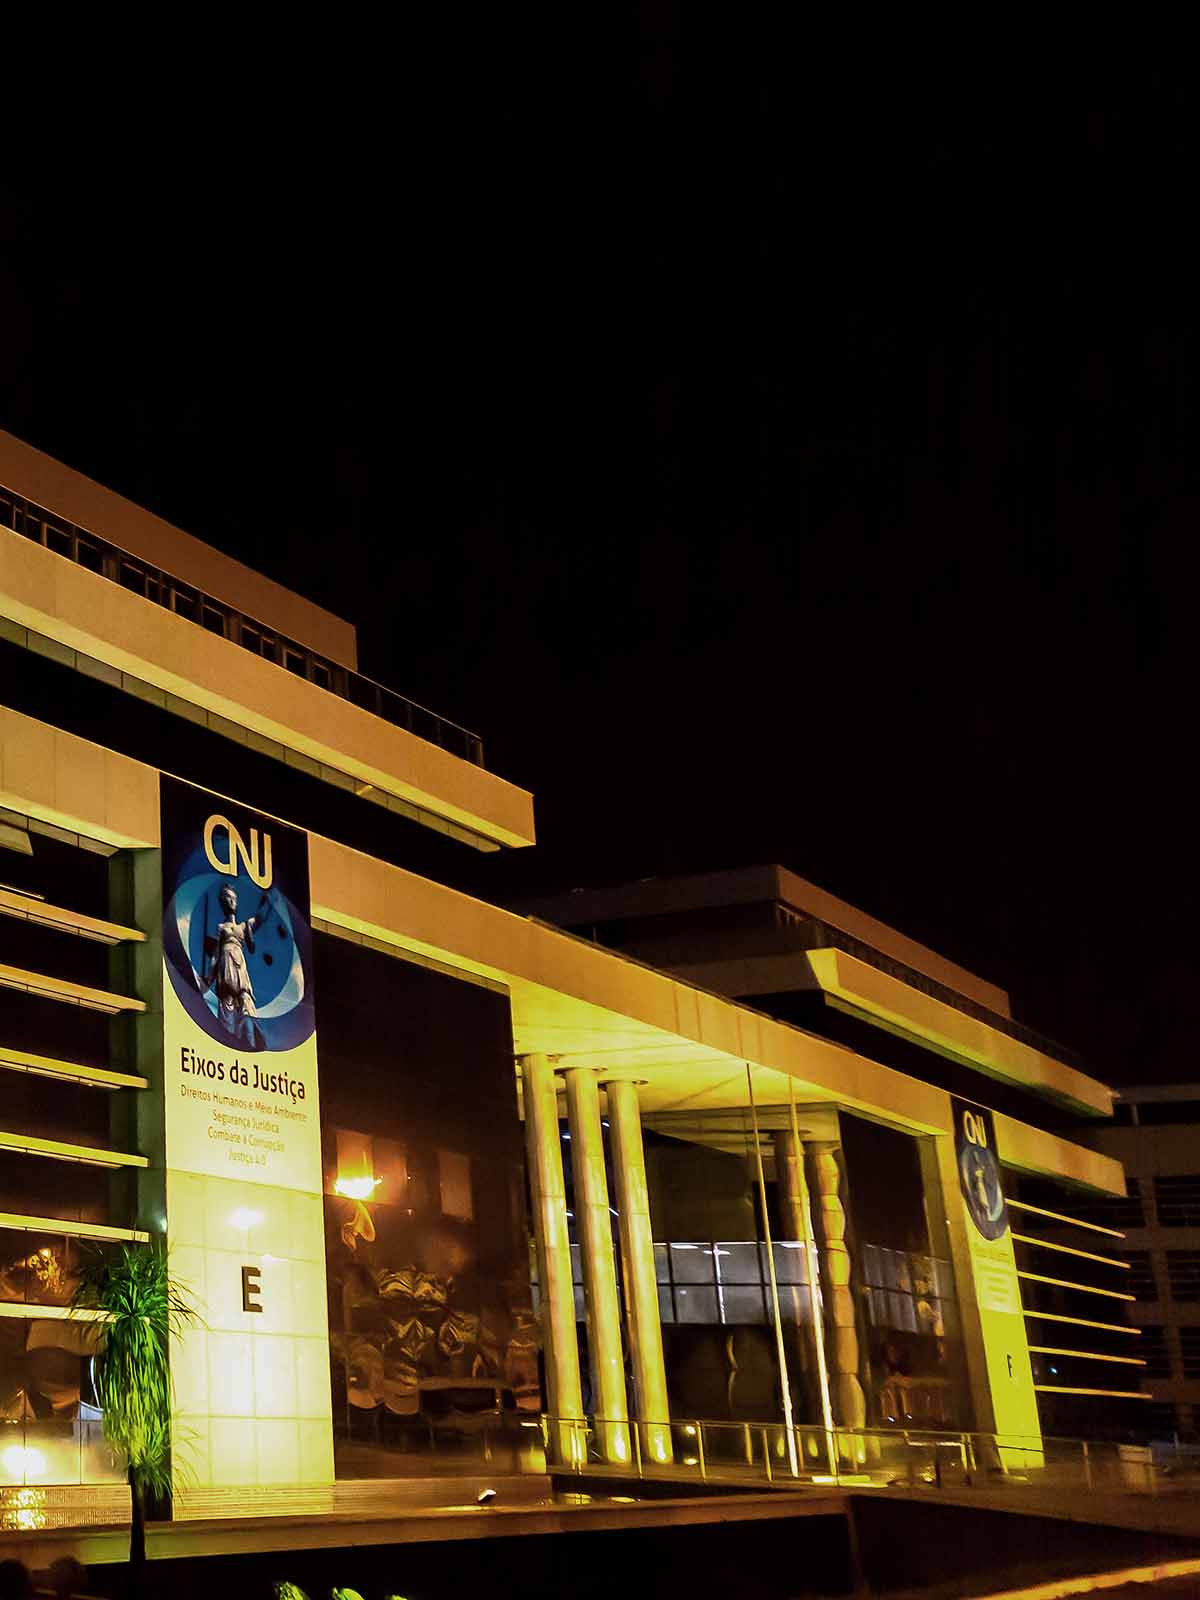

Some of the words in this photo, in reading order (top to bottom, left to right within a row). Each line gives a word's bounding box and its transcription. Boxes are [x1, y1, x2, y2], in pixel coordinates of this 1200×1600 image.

[203, 814, 273, 890] CNJ
[180, 1084, 211, 1101] Direitos
[213, 1091, 247, 1109] Humanos
[181, 1047, 225, 1080] Eixos
[229, 1059, 248, 1086] da
[253, 1064, 305, 1104] Justiça
[241, 1265, 263, 1313] E
